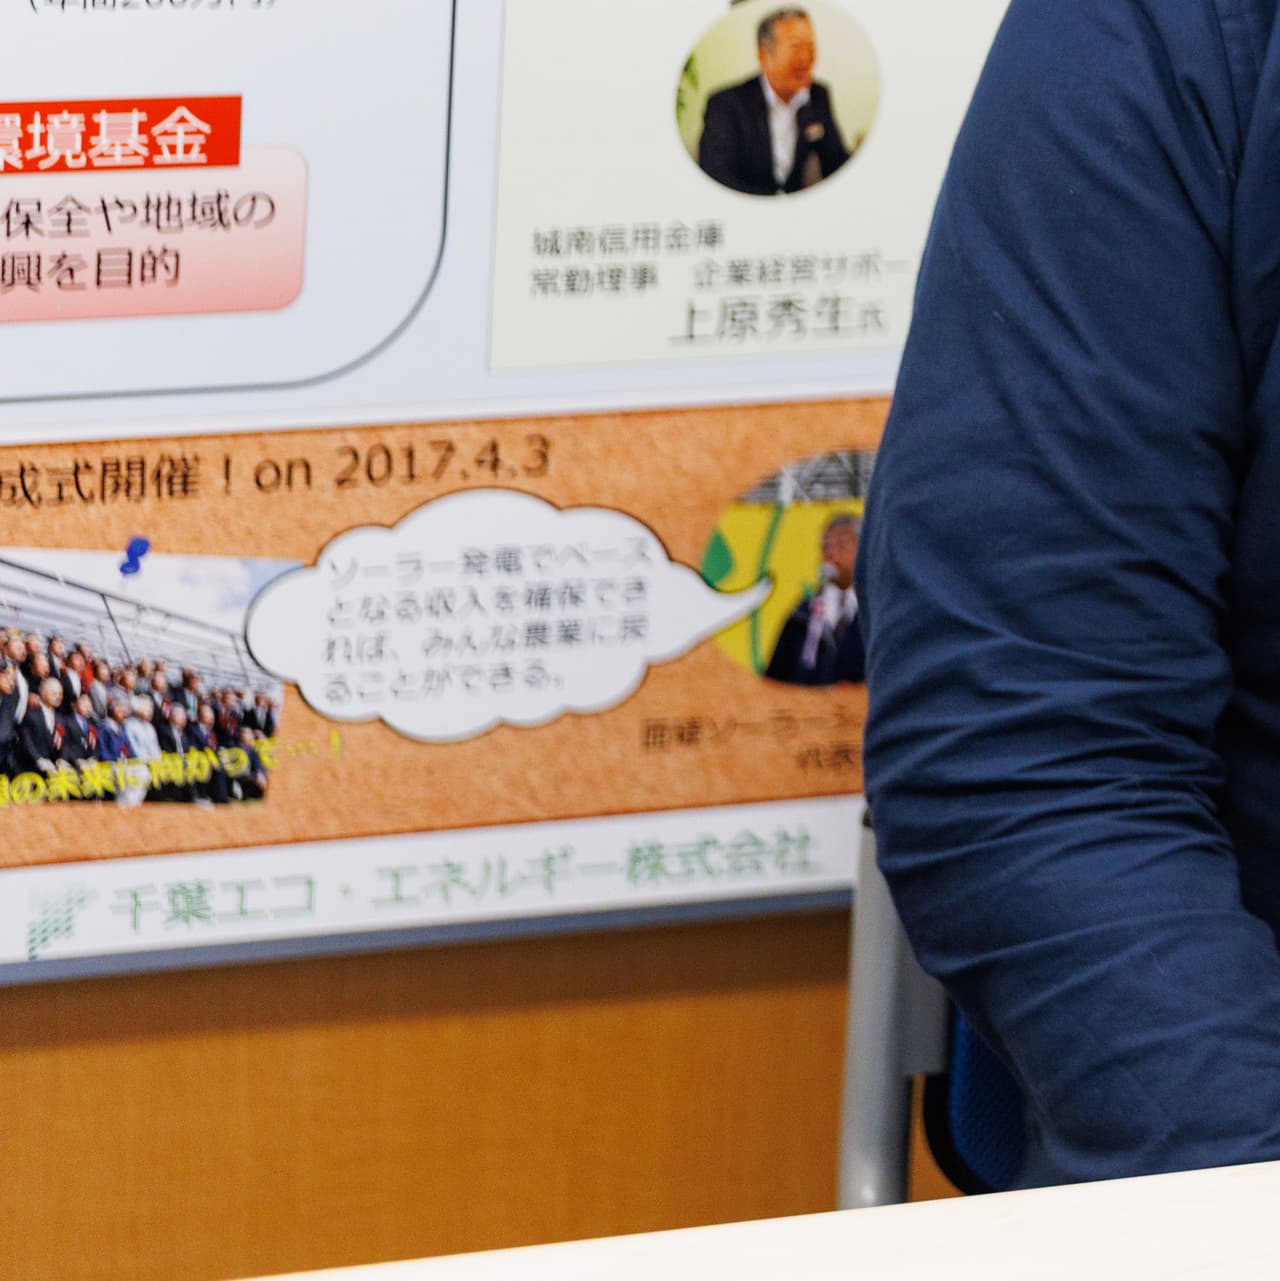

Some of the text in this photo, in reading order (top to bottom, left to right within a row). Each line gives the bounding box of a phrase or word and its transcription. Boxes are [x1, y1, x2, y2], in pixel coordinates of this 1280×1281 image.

[1, 190, 276, 238] 保全や地域の
[337, 434, 551, 487] 2017.4.3
